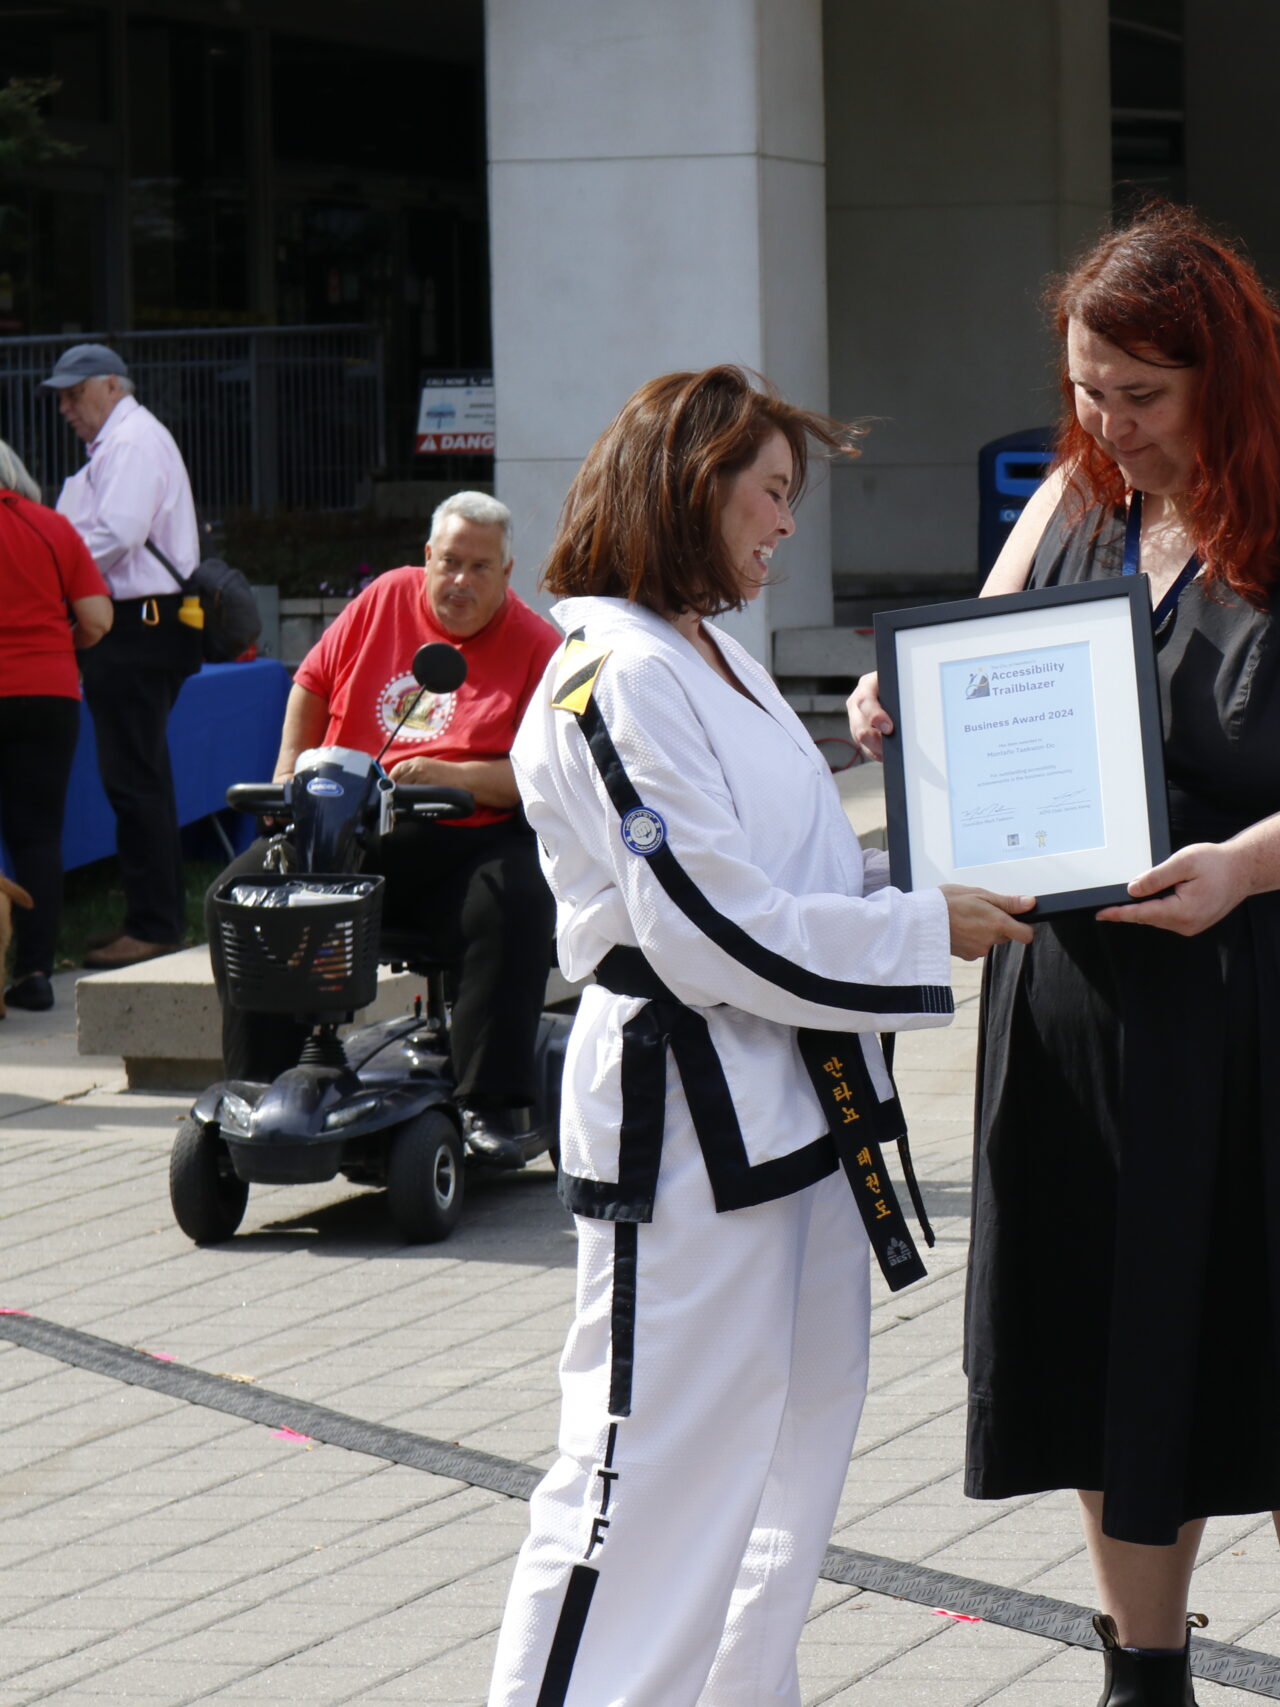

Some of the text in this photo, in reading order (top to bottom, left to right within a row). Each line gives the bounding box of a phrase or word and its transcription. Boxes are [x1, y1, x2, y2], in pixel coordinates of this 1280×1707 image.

[991, 662, 1065, 681] Accessibility
[992, 679, 1055, 696] Trailblazer
[964, 708, 1075, 733] Business Award 2024
[856, 1146, 892, 1219] 태권도
[584, 1422, 619, 1560] ITF
